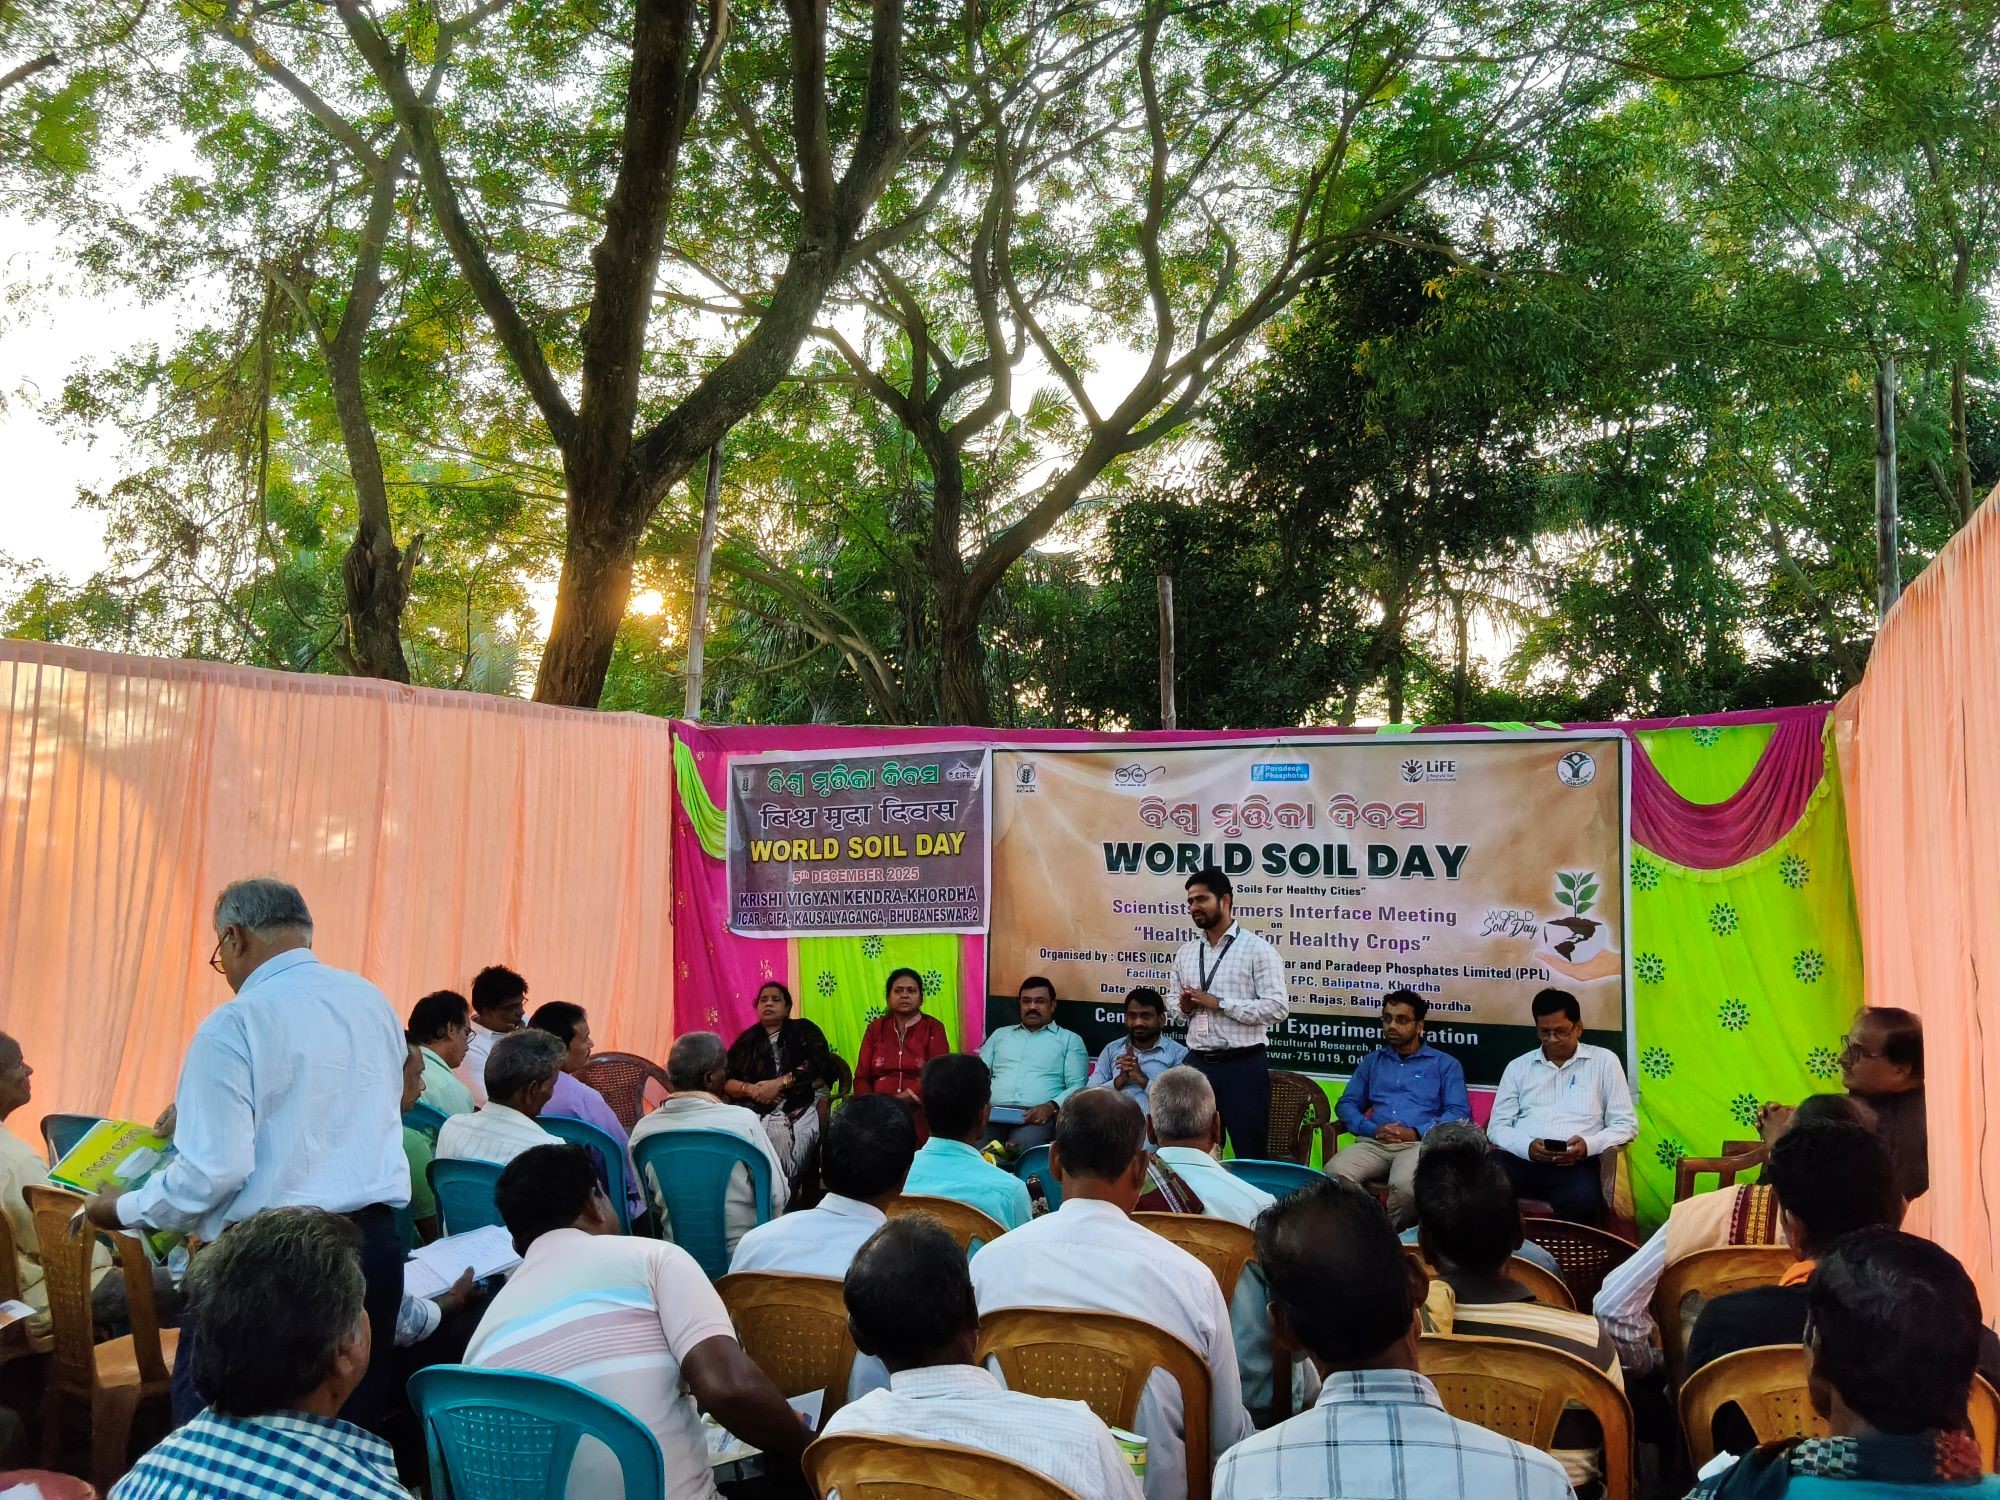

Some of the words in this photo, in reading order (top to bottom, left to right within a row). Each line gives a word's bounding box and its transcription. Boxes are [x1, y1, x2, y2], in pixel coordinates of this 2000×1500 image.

[881, 761, 939, 787] ଦିବସ
[1265, 772, 1308, 780] Phosphates
[1426, 760, 1456, 772] LiFE
[823, 805, 873, 830] मृदा
[879, 796, 958, 823] दिवस
[1327, 793, 1426, 829] ଦିବସ
[750, 838, 839, 862] WORLD
[848, 835, 908, 859] SOIL
[915, 831, 966, 857] DAY
[1103, 842, 1253, 875] WORLD
[1261, 843, 1358, 877] SOIL
[1367, 844, 1471, 880] DAY
[793, 870, 809, 884] 5th
[812, 868, 883, 882] DECEMBER
[887, 867, 920, 881] 2025
[740, 892, 783, 907] KRISHI
[786, 890, 840, 906] VIGYAN
[843, 886, 978, 906] KENDRA-KHORDHA
[1237, 884, 1263, 895] Soils
[1266, 885, 1283, 895] For
[1286, 885, 1327, 897] Healthy
[737, 912, 760, 926] ICAR
[767, 911, 791, 928] CIFA,
[794, 909, 888, 928] KAUSALYAGANGA,
[889, 907, 979, 923] BHUBANESWAR-2
[1232, 905, 1284, 918] rmers
[1290, 903, 1372, 920] Interface
[1378, 906, 1457, 926] Meeting
[1271, 921, 1283, 929] on
[1487, 910, 1534, 922] WORLD
[1134, 926, 1198, 944] “Health
[1289, 931, 1360, 952] Healthy
[1480, 918, 1508, 937] Soil
[1509, 919, 1540, 939] Day
[1040, 948, 1092, 961] Organised
[1094, 950, 1108, 963] by
[1117, 951, 1147, 963] CHES
[1300, 960, 1321, 970] and
[1325, 960, 1382, 975] Paradeep
[1385, 962, 1459, 977] Phosphates
[1463, 965, 1511, 979] Limited
[1515, 967, 1550, 981] (PPL)
[1126, 968, 1171, 980] Facilitat
[1291, 975, 1318, 987] FPC,
[1321, 977, 1384, 990] Balipatna,
[1388, 980, 1441, 993] Khordha
[1100, 983, 1126, 993] Date
[1309, 994, 1346, 1006] Rajas,
[1350, 996, 1383, 1009] Balip
[1427, 1000, 1472, 1012] hordha
[1287, 1018, 1385, 1039] Experimen
[1269, 1038, 1317, 1049] ticultural
[1320, 1041, 1371, 1053] Research,
